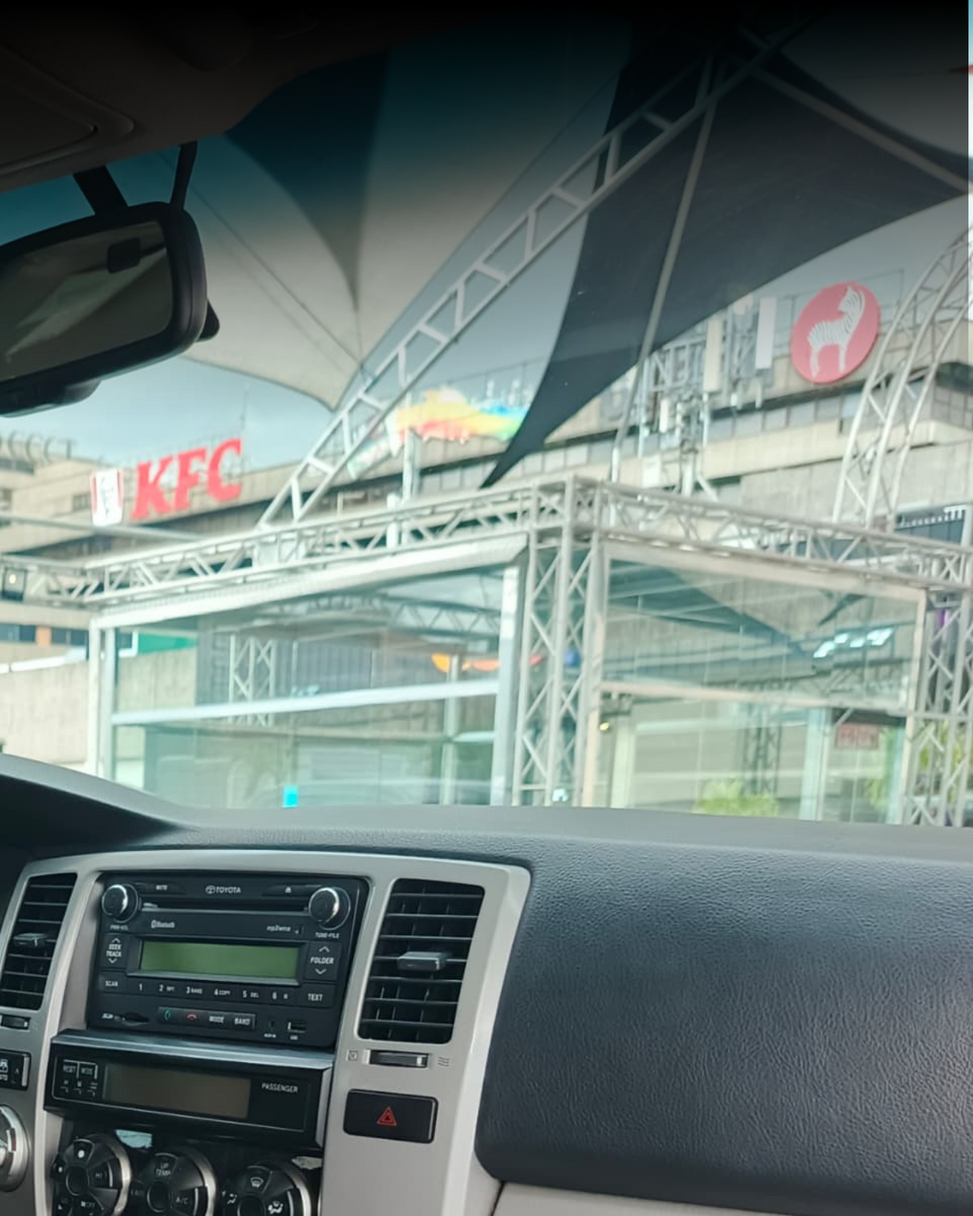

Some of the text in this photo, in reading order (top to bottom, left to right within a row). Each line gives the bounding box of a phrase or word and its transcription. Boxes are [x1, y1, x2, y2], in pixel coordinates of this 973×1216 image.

[130, 437, 242, 521] KFC
[215, 886, 241, 894] TOYOTA
[310, 956, 334, 964] FOLDER
[308, 993, 323, 1001] TEXT
[261, 1082, 298, 1093] PASSENGER
